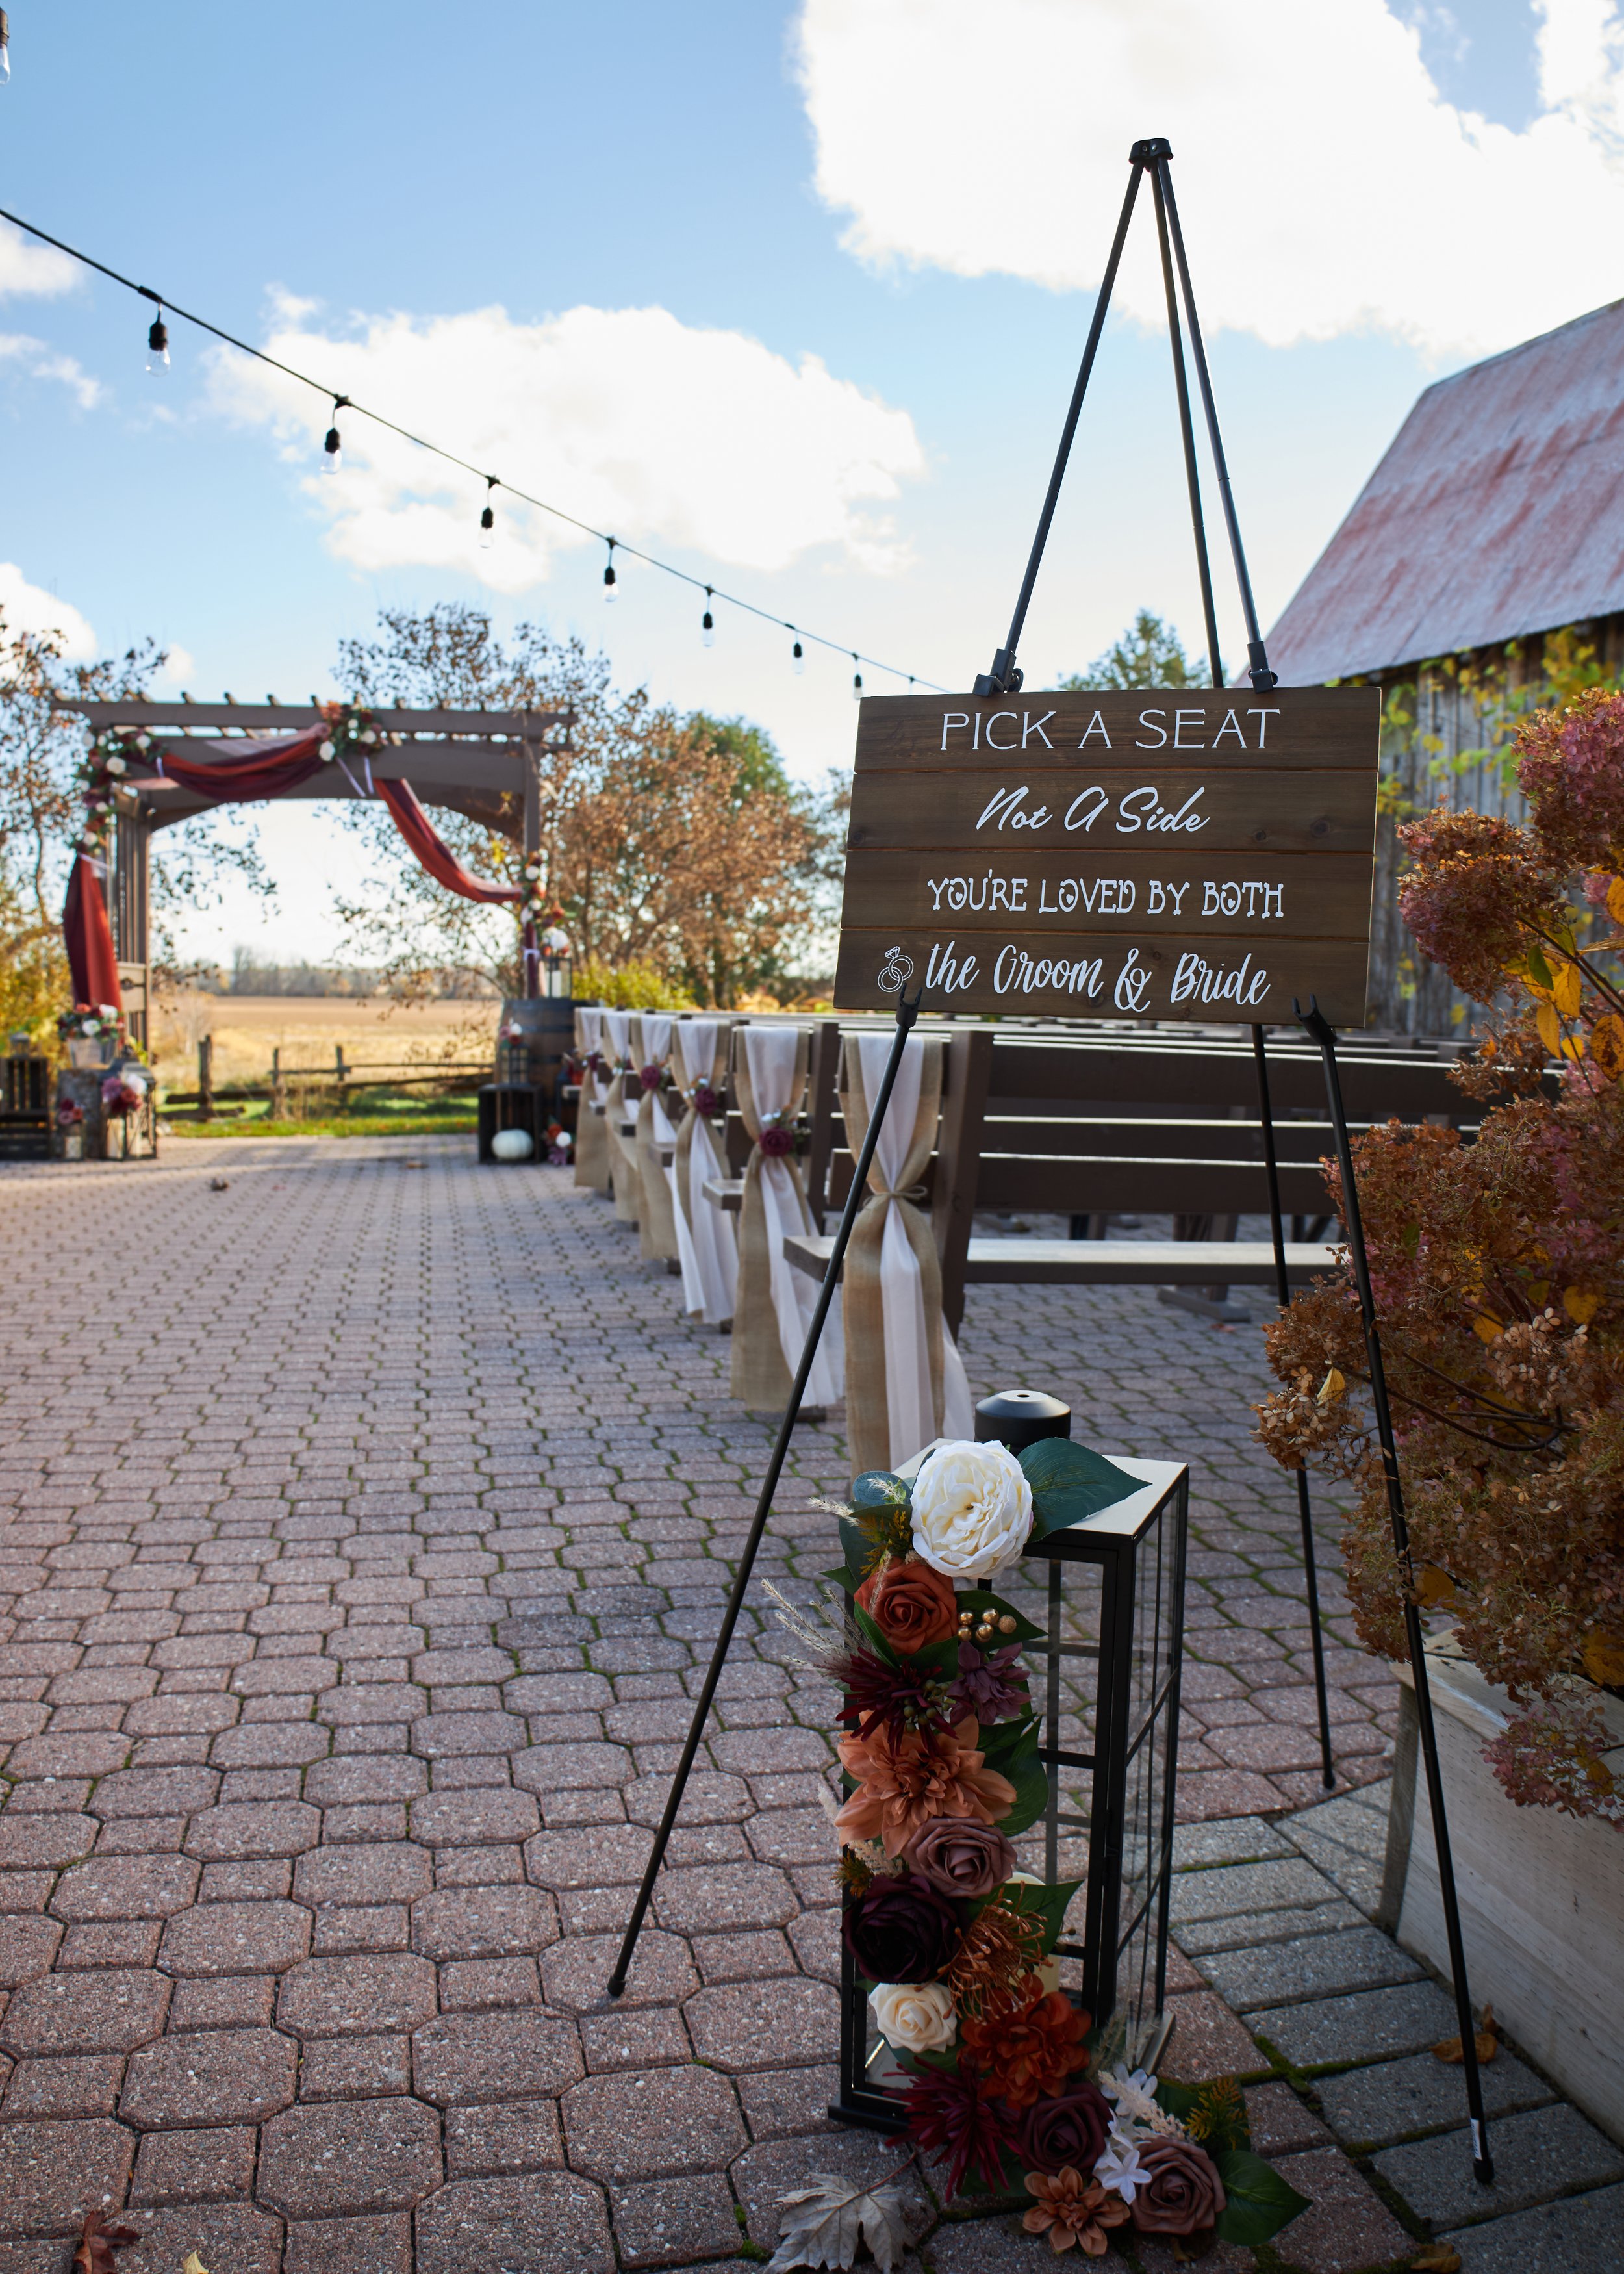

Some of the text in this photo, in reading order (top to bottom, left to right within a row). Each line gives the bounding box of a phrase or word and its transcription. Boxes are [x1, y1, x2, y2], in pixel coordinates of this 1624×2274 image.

[940, 708, 1281, 750] PICK A SEAT
[976, 786, 1210, 832] Not A Side
[927, 869, 1284, 919] YOU'RE LOVED BY BOTH
[926, 940, 1271, 1012] the Groom & Bride
